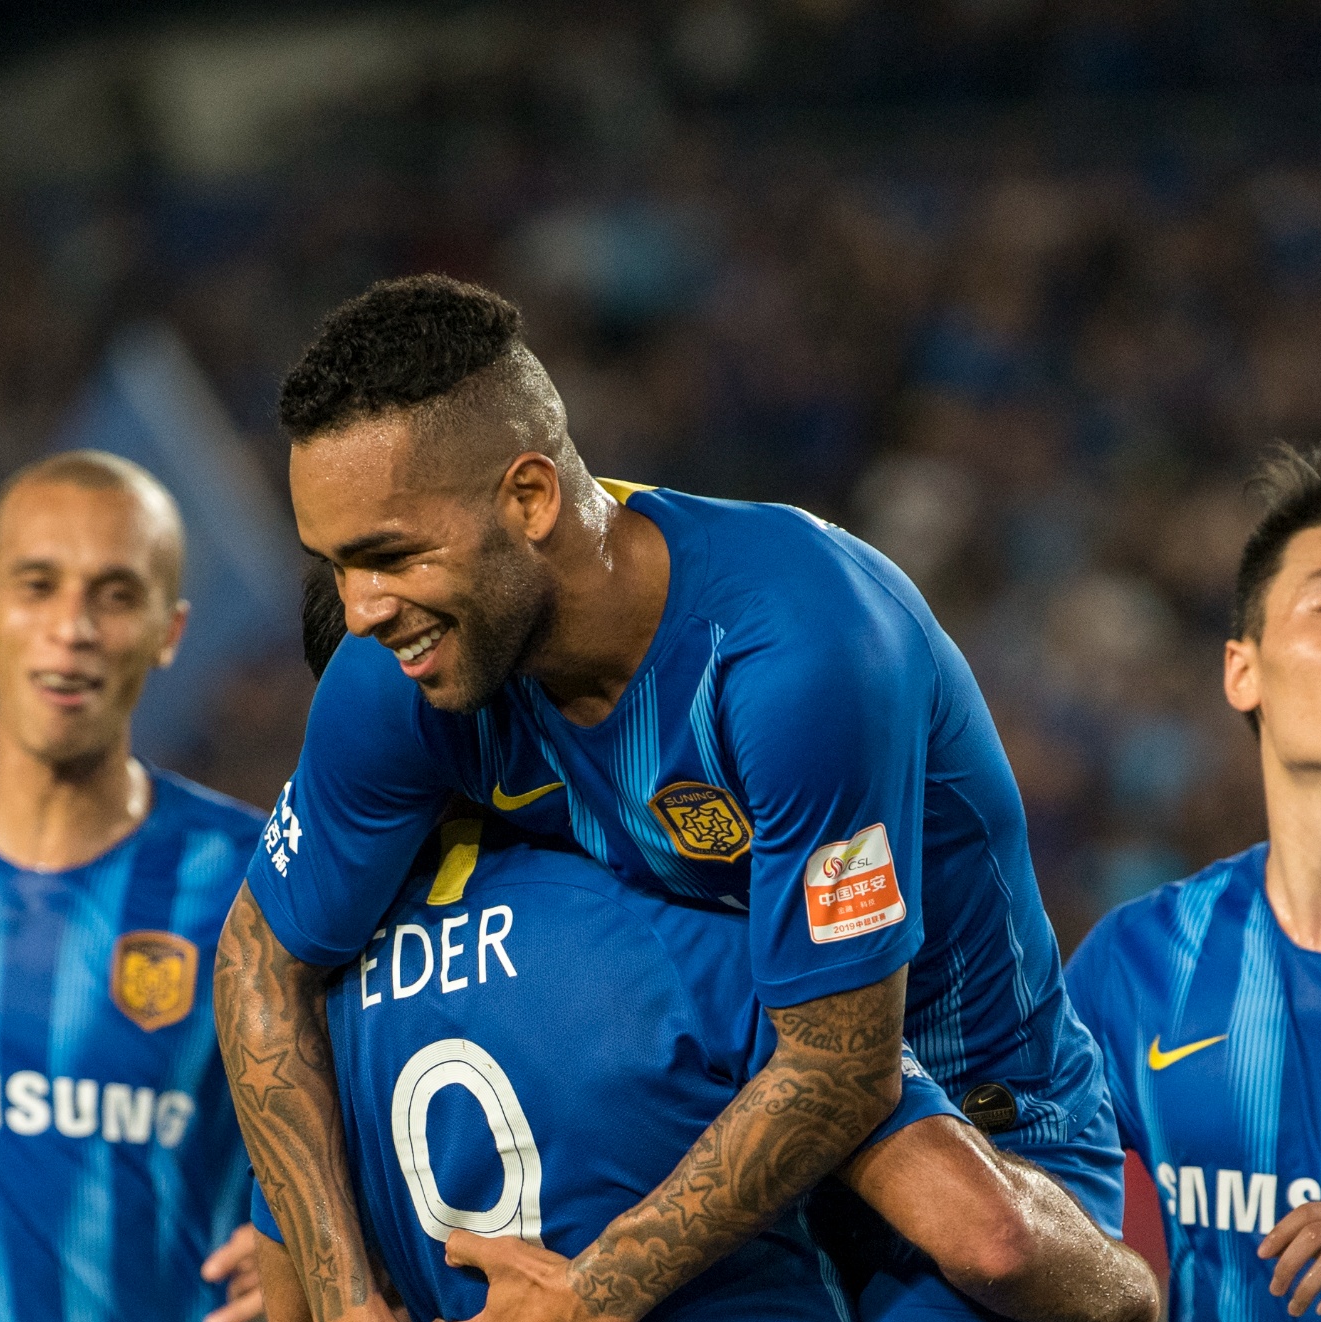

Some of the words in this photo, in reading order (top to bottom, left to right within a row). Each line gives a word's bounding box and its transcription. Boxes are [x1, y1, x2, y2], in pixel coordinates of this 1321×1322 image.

[663, 791, 716, 807] SUNING
[848, 857, 873, 871] CSL
[818, 874, 887, 907] 中国平安
[360, 904, 518, 1010] EDER
